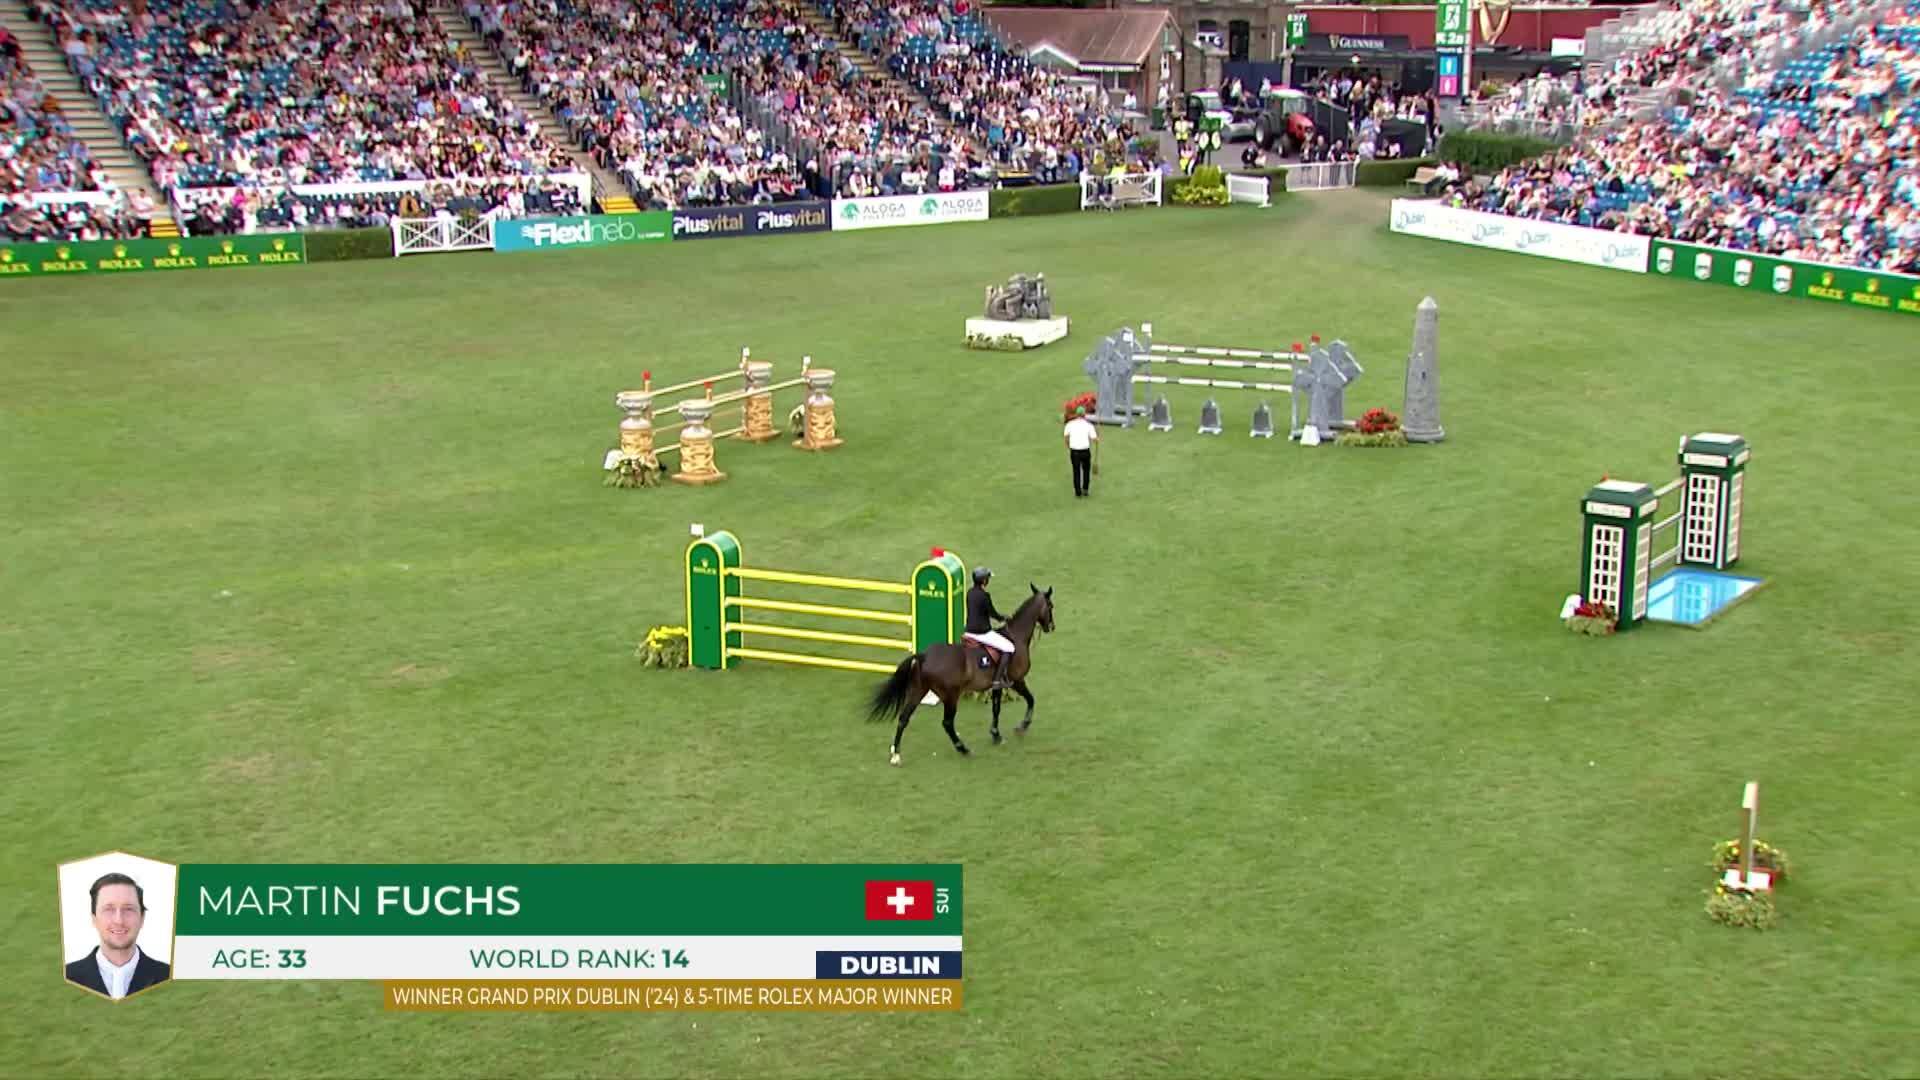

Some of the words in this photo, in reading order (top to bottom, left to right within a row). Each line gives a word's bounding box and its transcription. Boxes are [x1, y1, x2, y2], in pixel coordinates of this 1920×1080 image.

[1340, 37, 1385, 48] GUINNESS
[863, 203, 905, 215] ALOGA
[942, 199, 983, 209] ALOGA
[673, 213, 743, 235] Plusvital
[757, 208, 825, 230] Plusvital
[153, 255, 196, 268] ROLEX
[207, 253, 249, 265] ROLEX
[259, 251, 300, 263] ROLEX
[42, 260, 88, 272] ROLEX
[99, 258, 143, 270] ROLEX
[1808, 285, 1844, 300] ROLEX
[1852, 291, 1890, 307] ROLEX
[693, 566, 717, 575] ROLEX
[919, 589, 945, 598] ROLEX
